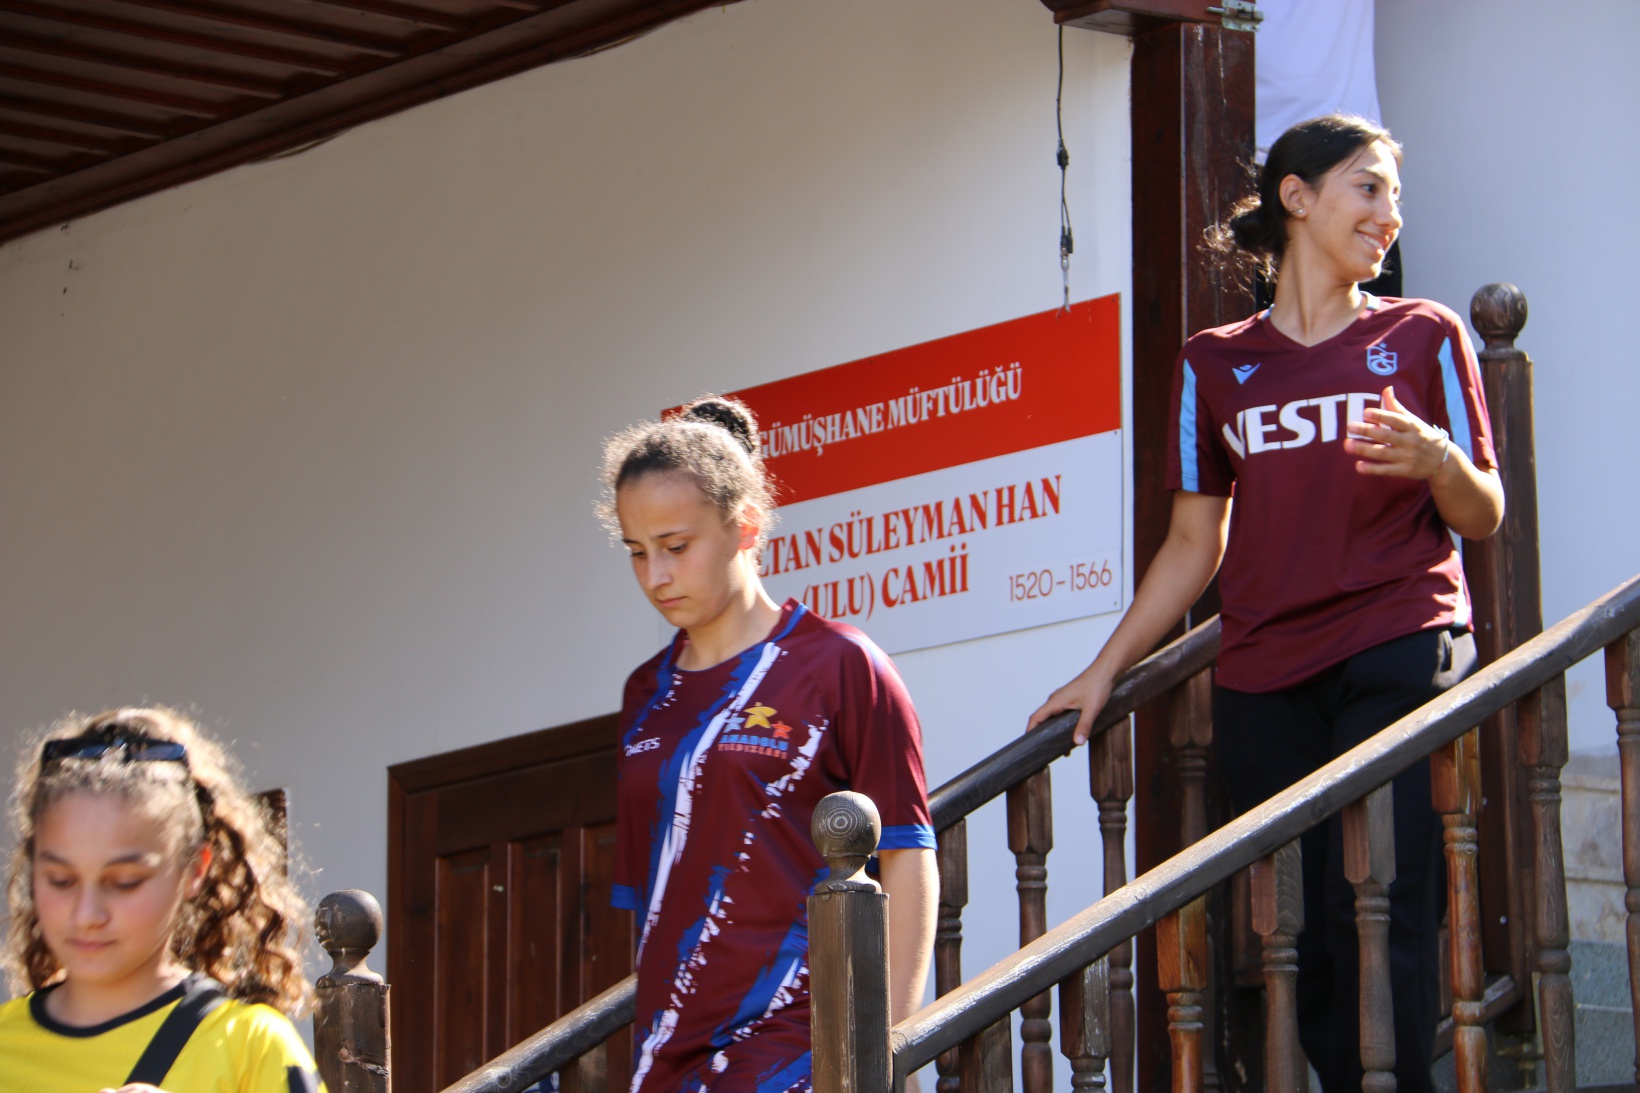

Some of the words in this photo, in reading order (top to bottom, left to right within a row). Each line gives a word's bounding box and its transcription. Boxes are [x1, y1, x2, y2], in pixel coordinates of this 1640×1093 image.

[887, 362, 1023, 429] MÜFTÜLÜĞÜ
[1222, 392, 1392, 459] VESTE
[828, 490, 989, 563] SÜLEYMAN
[994, 474, 1062, 527] HAN
[802, 572, 875, 621] (ULU)
[881, 542, 969, 608] CAMİİ
